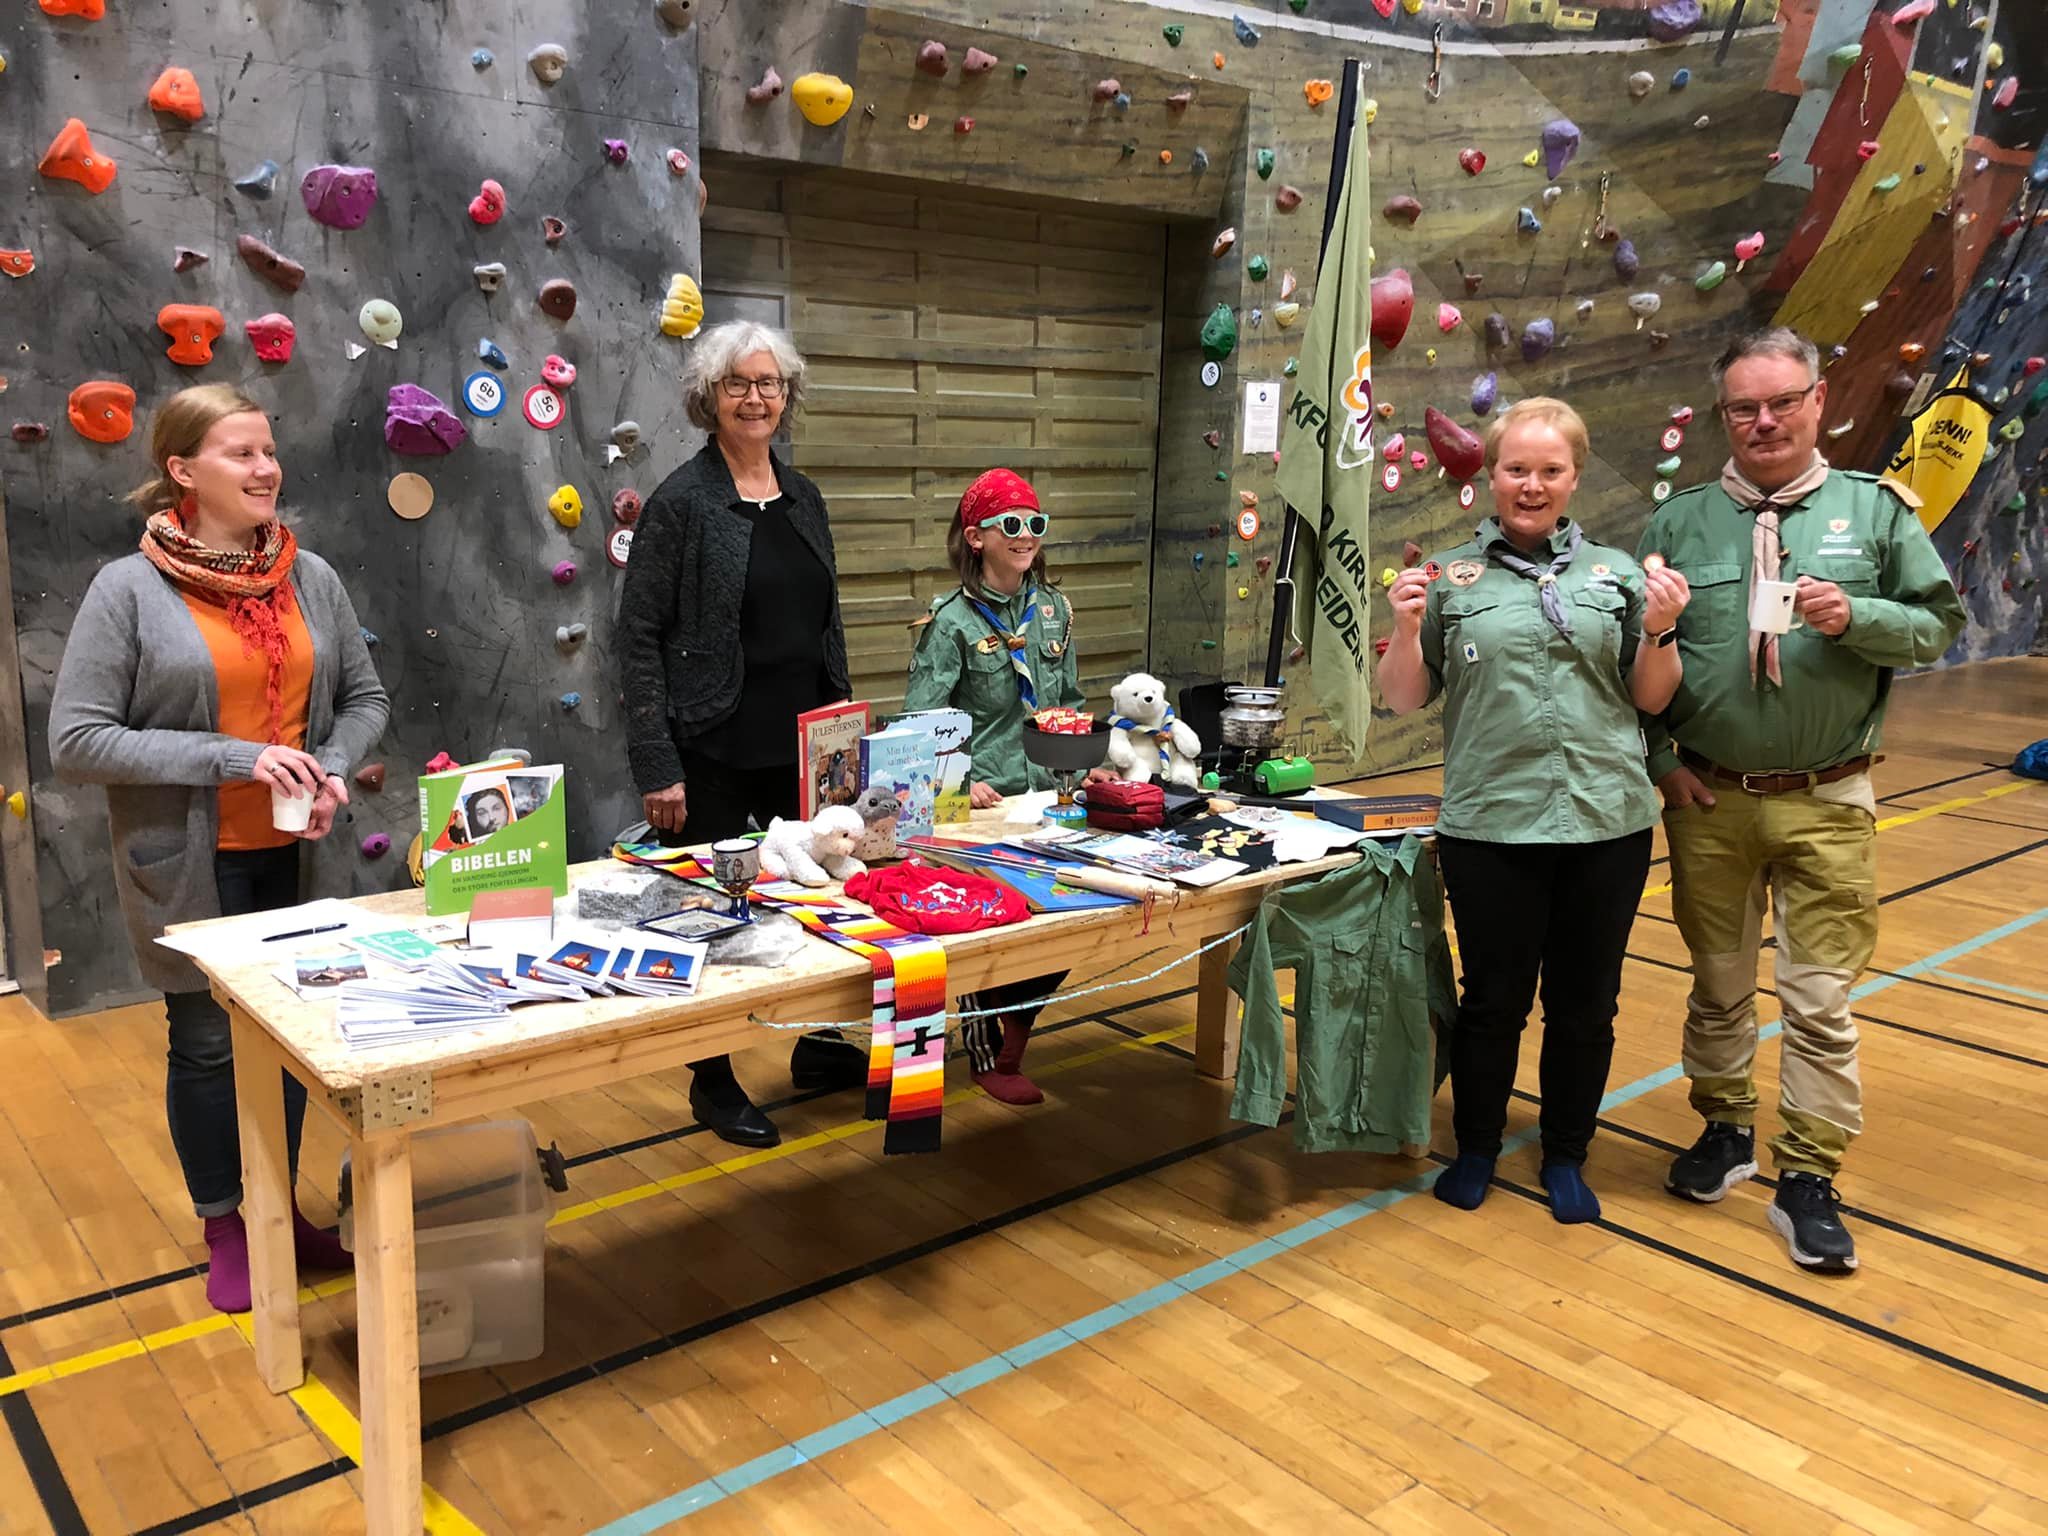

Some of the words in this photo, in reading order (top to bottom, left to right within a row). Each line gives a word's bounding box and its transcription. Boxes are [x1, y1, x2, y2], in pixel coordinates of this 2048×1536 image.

[479, 381, 496, 399] 6b
[541, 395, 555, 413] 5c
[812, 719, 863, 739] JULESTJERNEN
[450, 847, 532, 874] BIBELEN
